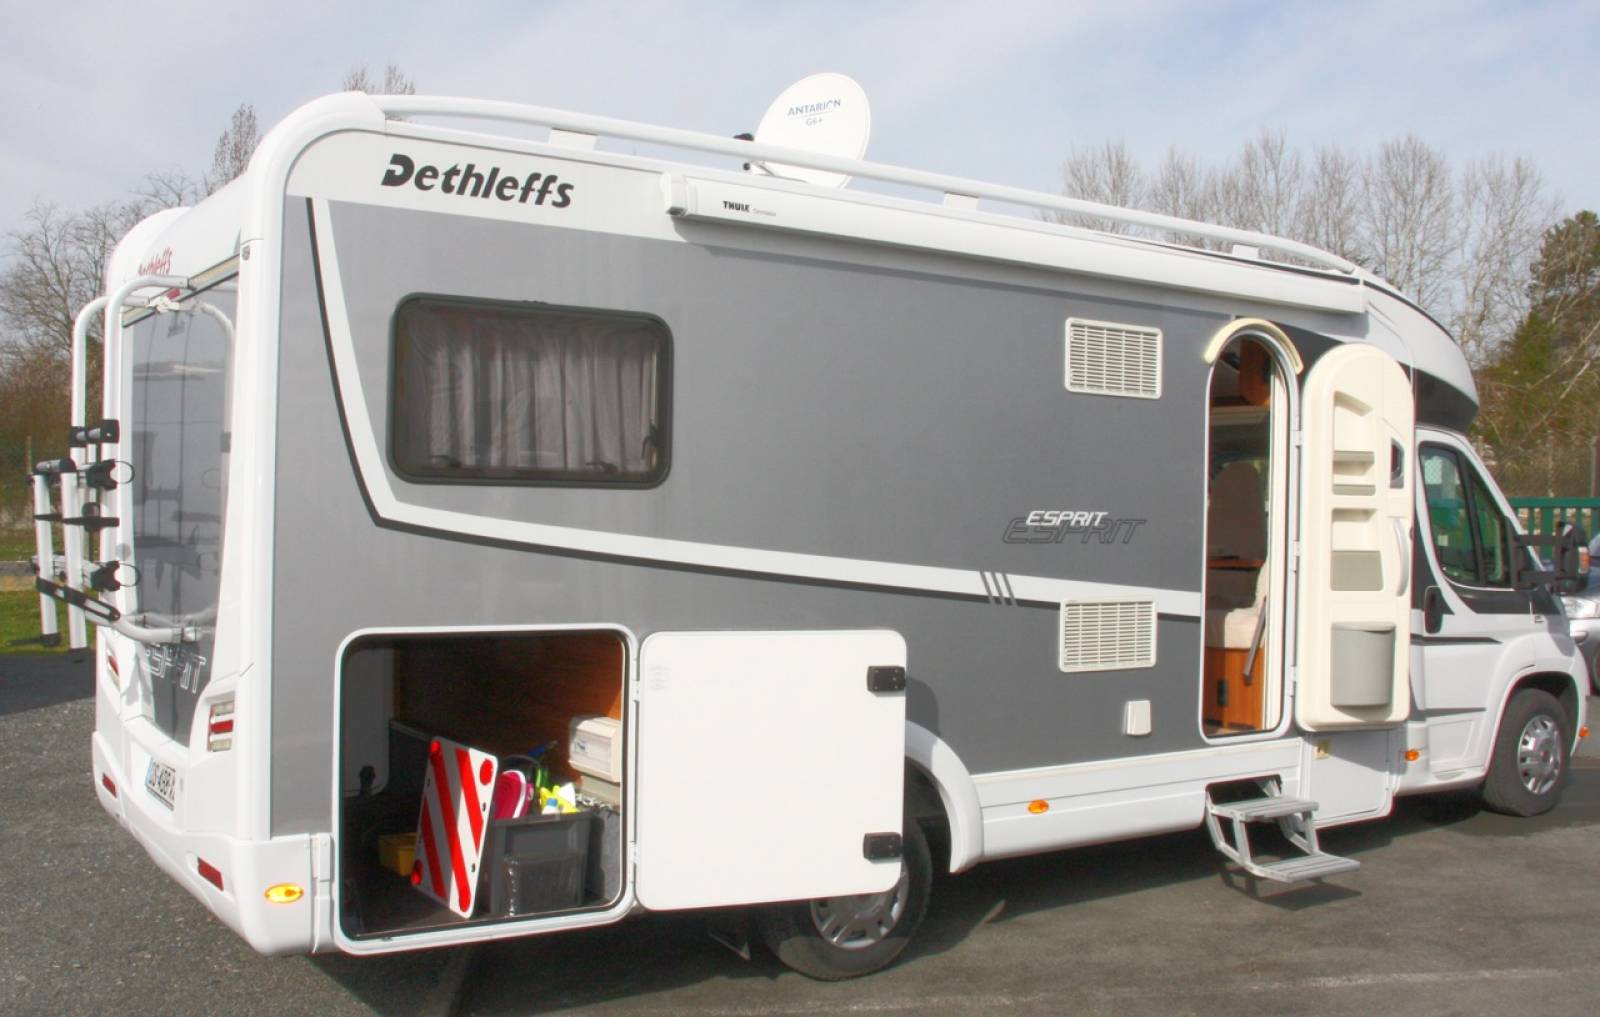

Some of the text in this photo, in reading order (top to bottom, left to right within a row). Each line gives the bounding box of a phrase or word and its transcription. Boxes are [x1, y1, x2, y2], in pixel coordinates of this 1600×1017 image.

[381, 153, 574, 209] Dethleffs
[722, 200, 751, 213] THULE
[1025, 510, 1109, 527] ESPRIT
